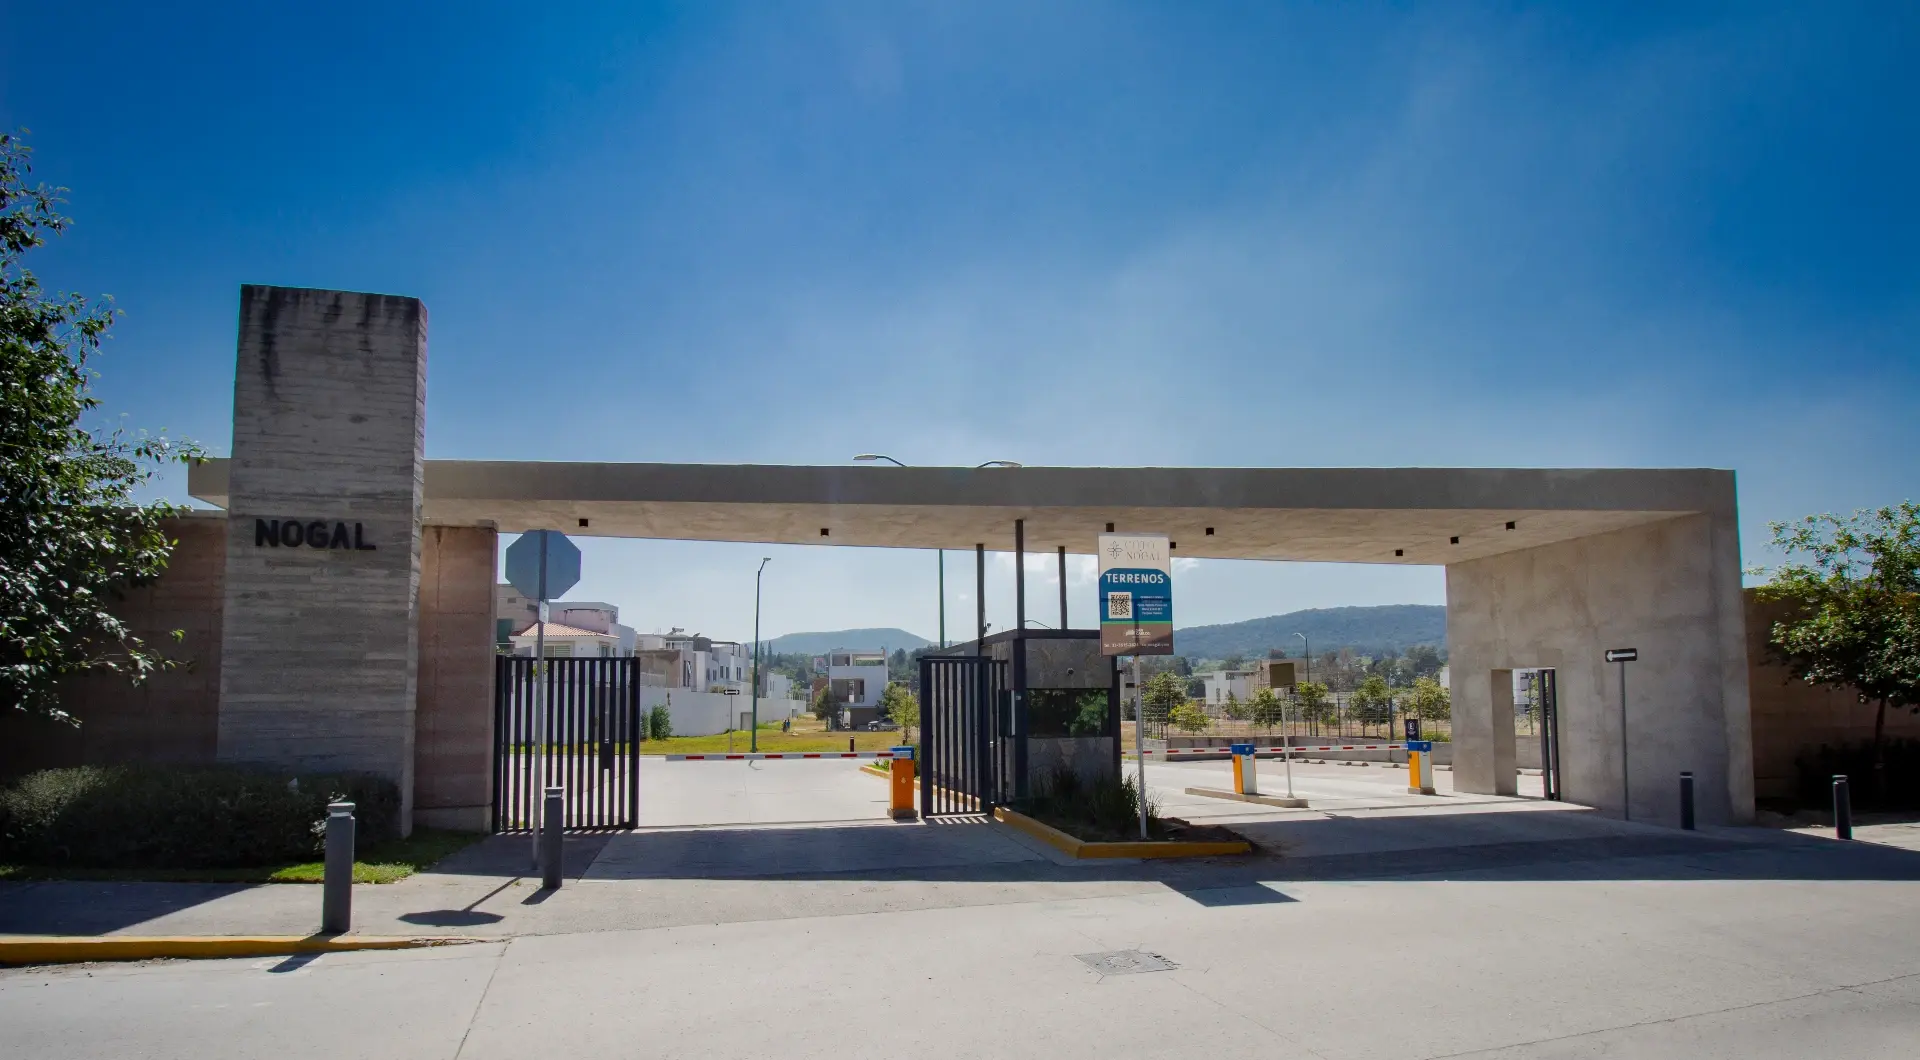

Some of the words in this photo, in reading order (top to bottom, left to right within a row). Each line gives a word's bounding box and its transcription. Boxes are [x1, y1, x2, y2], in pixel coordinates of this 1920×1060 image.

[255, 518, 377, 551] NOGAL
[1126, 552, 1163, 561] NOGAL
[1105, 573, 1164, 584] TERRENOS
